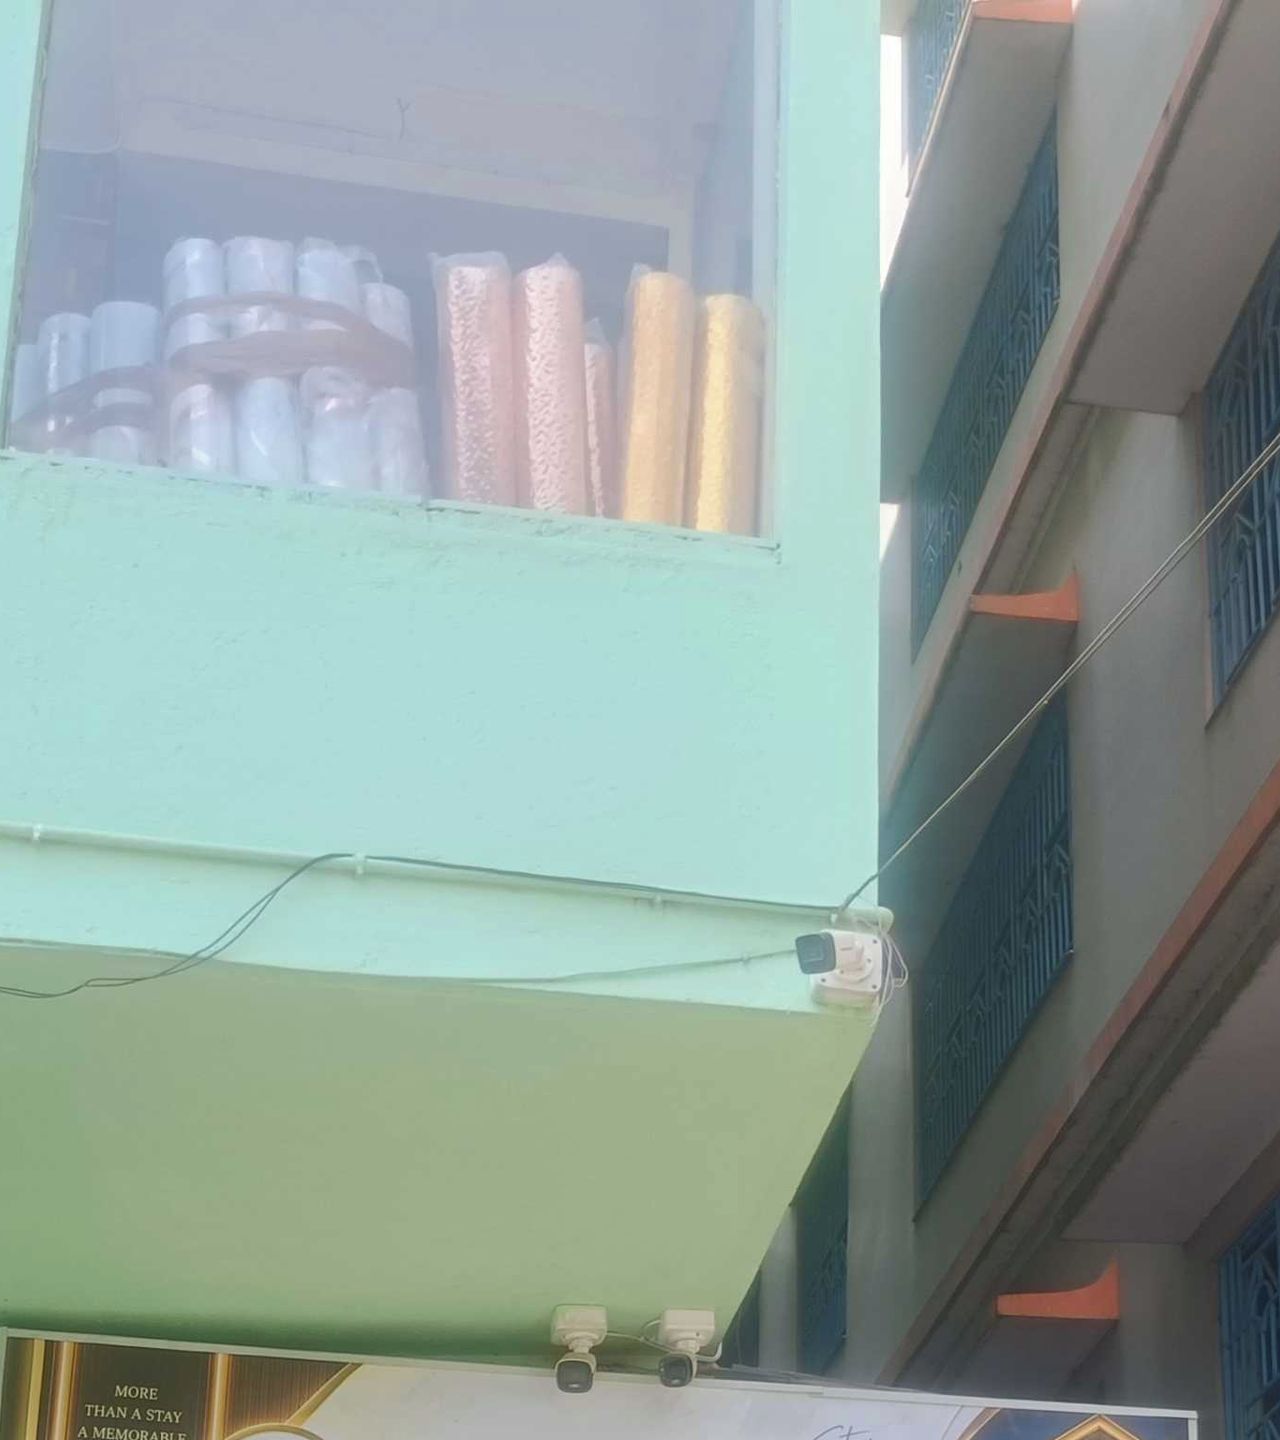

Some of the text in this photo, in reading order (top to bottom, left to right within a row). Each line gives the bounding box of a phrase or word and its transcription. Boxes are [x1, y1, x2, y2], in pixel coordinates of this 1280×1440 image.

[114, 1385, 159, 1401] MORE
[84, 1403, 183, 1424] THAN A STAY
[77, 1426, 88, 1440] A
